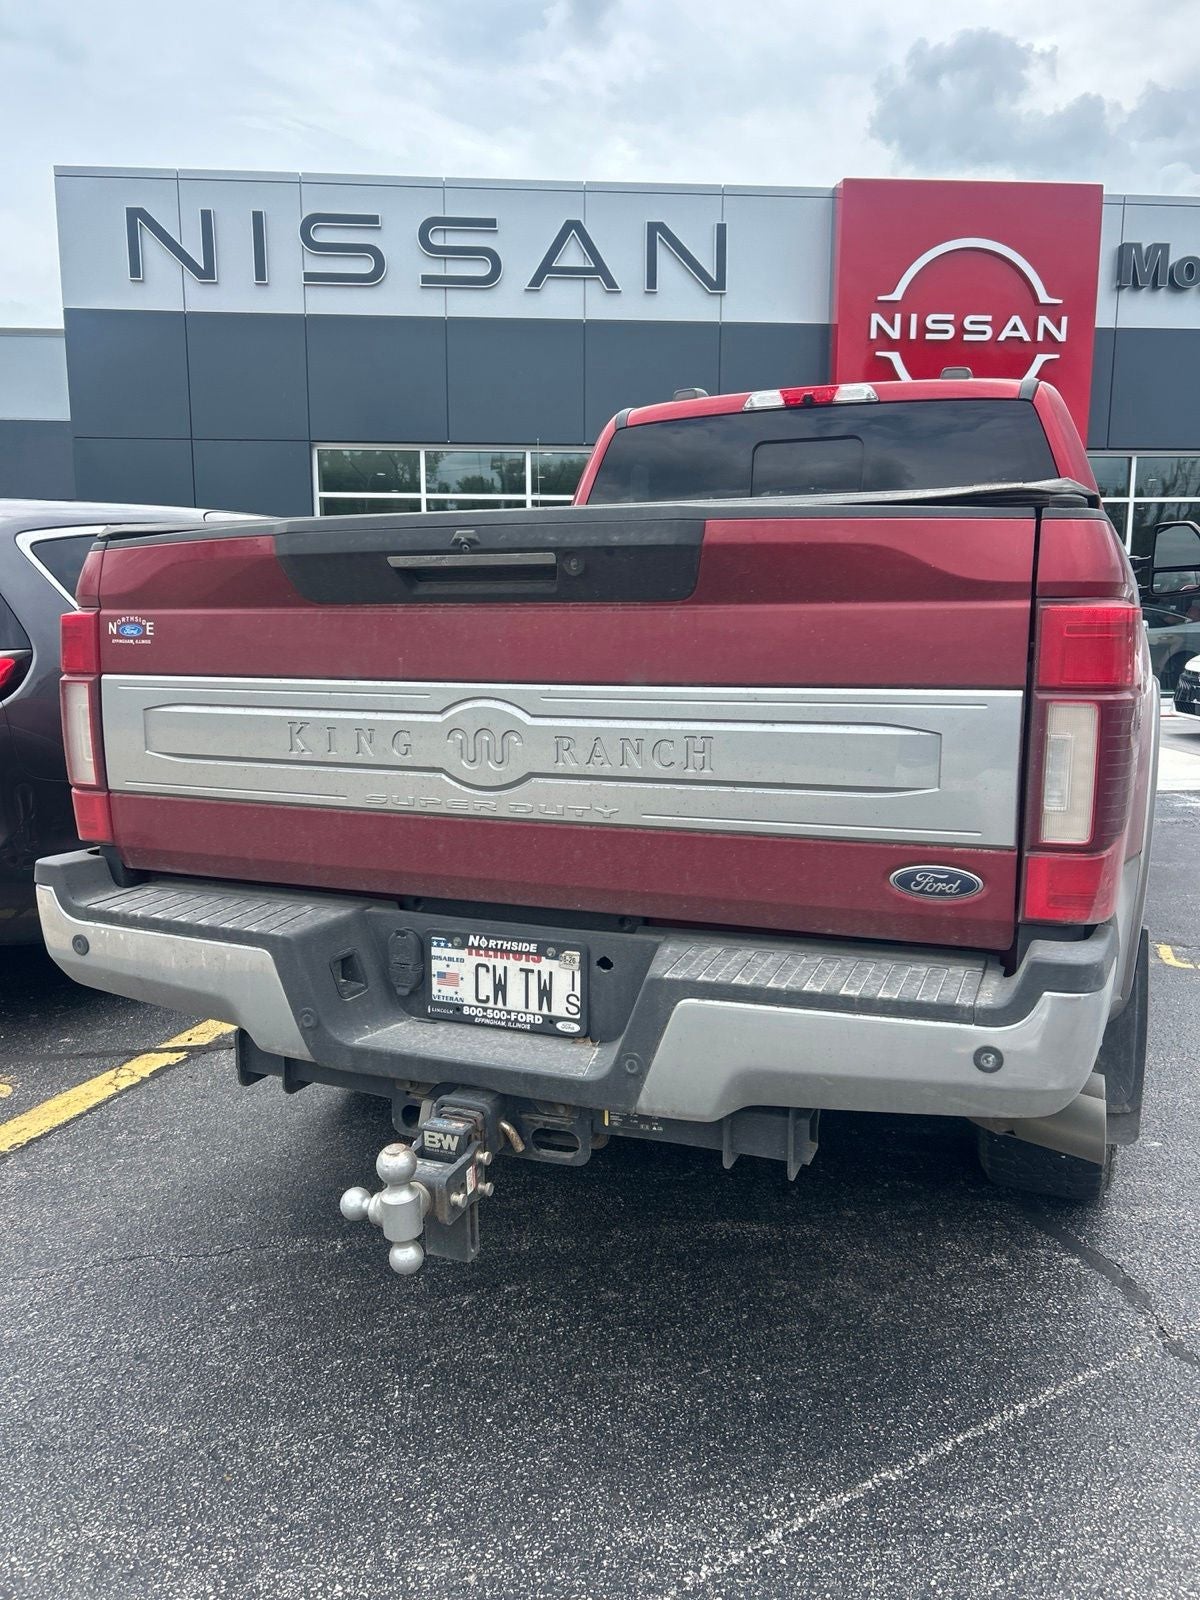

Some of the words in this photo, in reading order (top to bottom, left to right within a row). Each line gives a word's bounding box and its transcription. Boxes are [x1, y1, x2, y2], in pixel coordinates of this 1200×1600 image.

[125, 206, 729, 294] NISSAN
[1117, 242, 1200, 289] Mo
[869, 312, 1068, 343] NISSAN
[287, 721, 413, 758] KING
[554, 735, 714, 773] RANCH
[365, 793, 498, 812] SUPER
[508, 802, 619, 819] DUTY
[910, 872, 961, 894] Ford
[468, 935, 538, 952] NORTHSIDE
[432, 955, 464, 963] DISABLED
[432, 994, 465, 1003] VETERAN
[475, 963, 508, 1007] CW
[519, 968, 553, 1013] TW
[463, 1006, 543, 1024] 800-500-FORD
[507, 1020, 531, 1030] ILLINOIS
